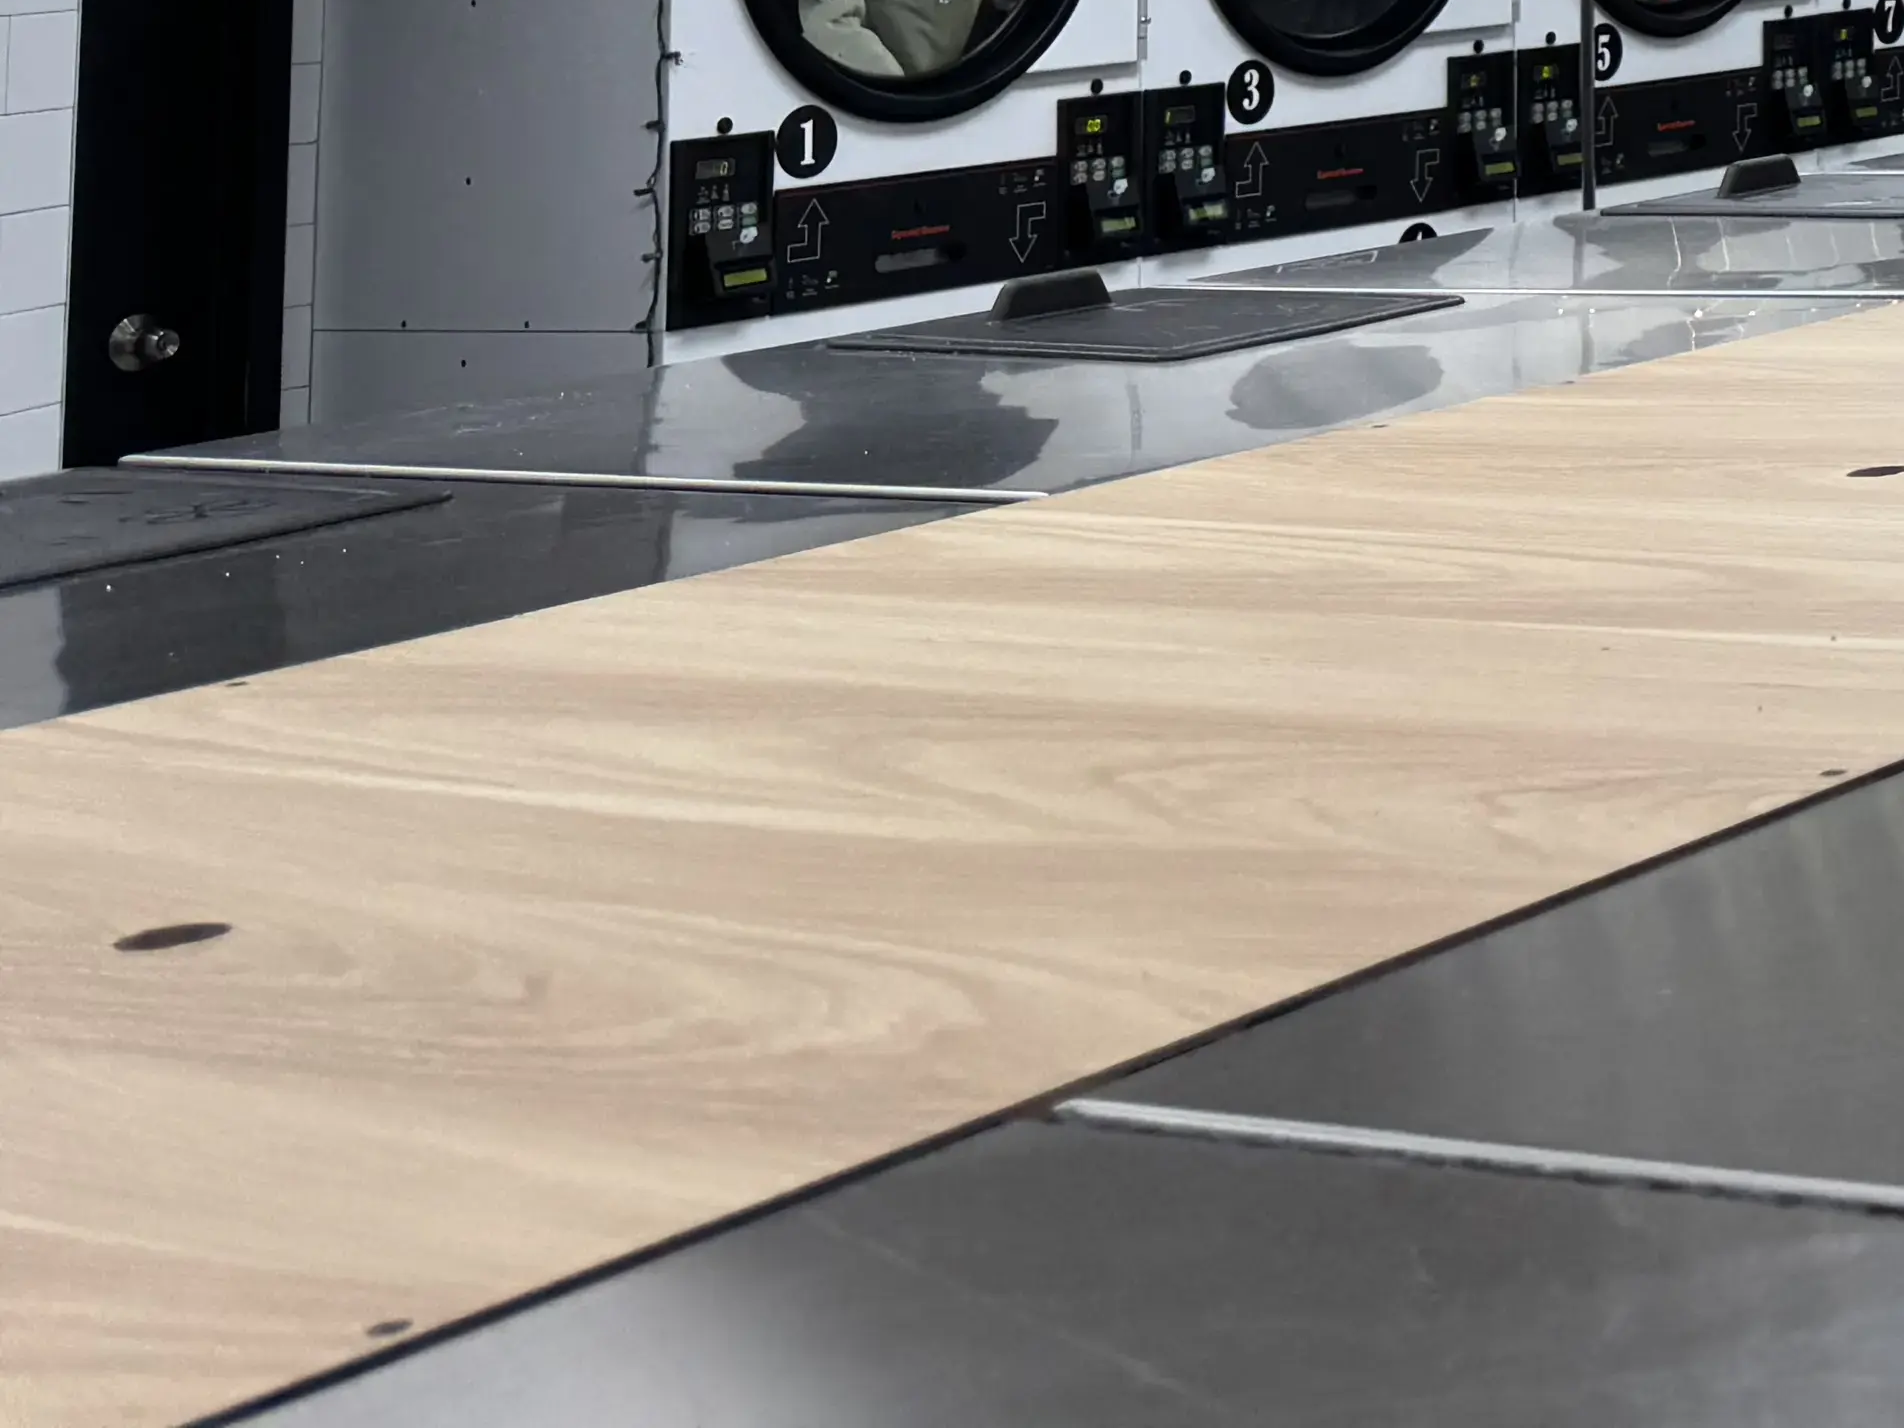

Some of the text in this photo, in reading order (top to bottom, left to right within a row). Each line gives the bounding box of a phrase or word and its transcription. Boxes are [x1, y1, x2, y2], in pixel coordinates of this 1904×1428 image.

[1884, 0, 1896, 33] 7
[1597, 34, 1611, 72] 5
[1242, 68, 1260, 111] 3
[800, 118, 816, 166] 1
